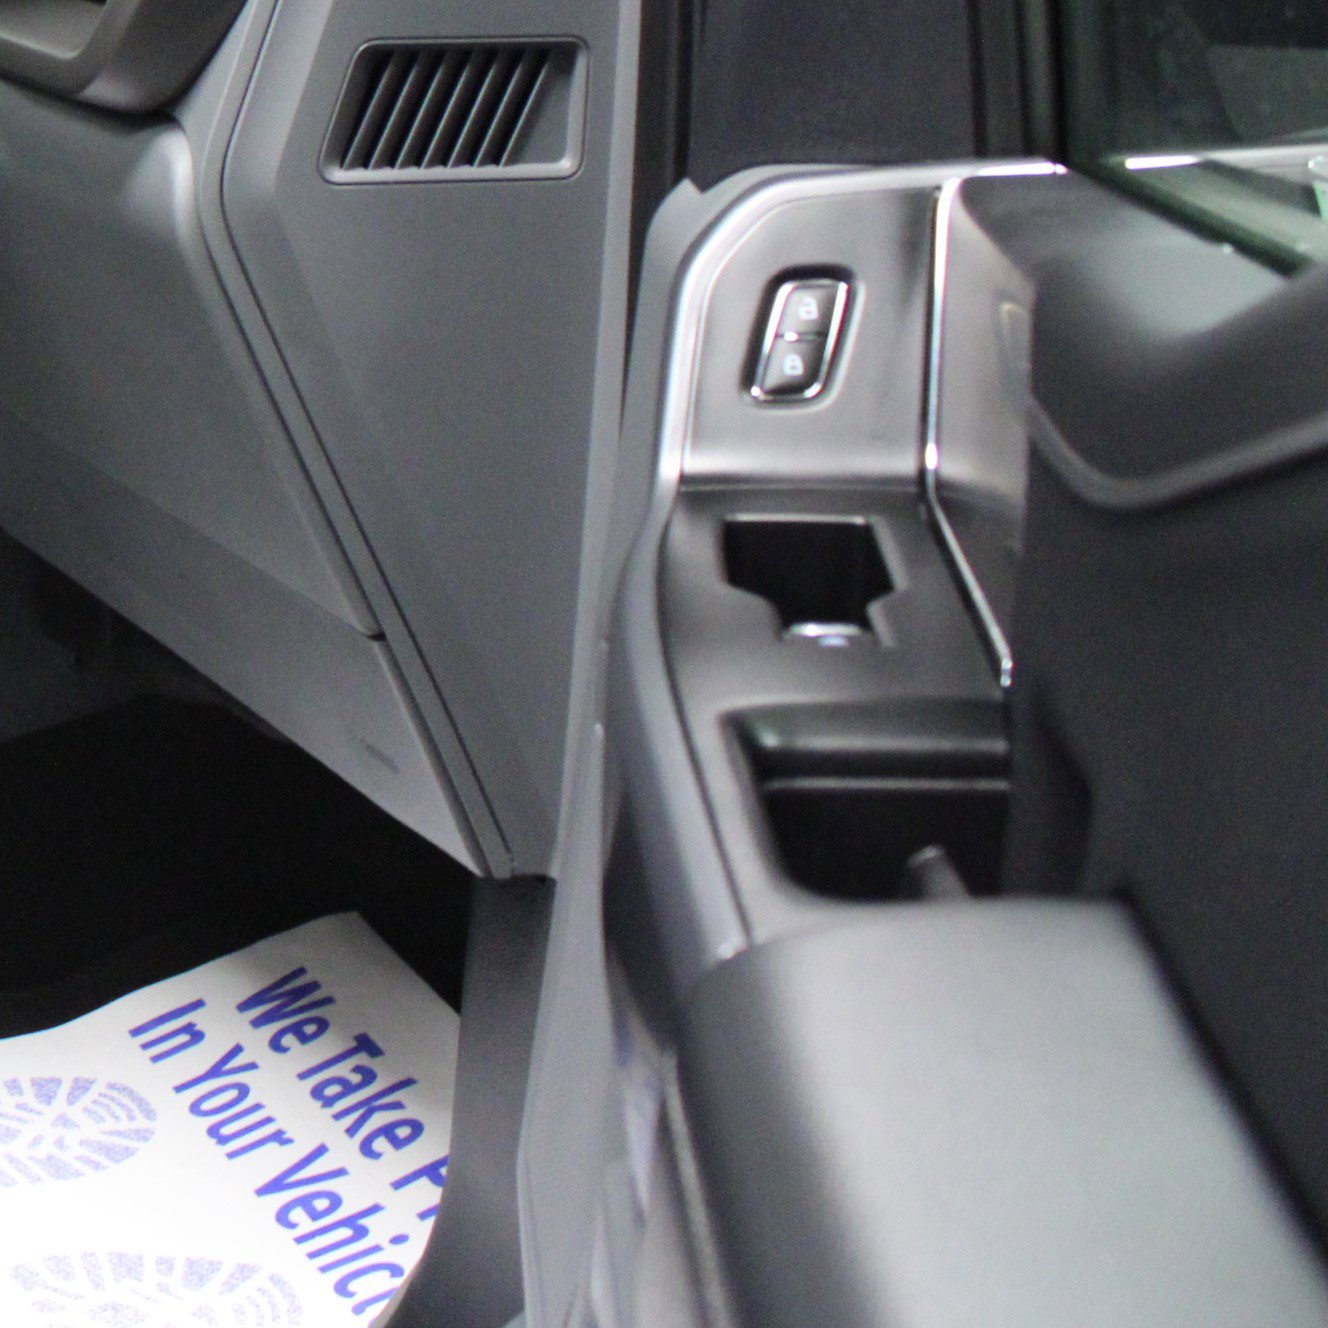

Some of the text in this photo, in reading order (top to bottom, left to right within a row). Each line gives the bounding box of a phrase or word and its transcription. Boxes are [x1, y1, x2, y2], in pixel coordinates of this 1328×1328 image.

[128, 998, 206, 1064] In
[172, 1043, 294, 1160] Your
[236, 966, 336, 1054] We
[296, 1032, 424, 1160] Take
